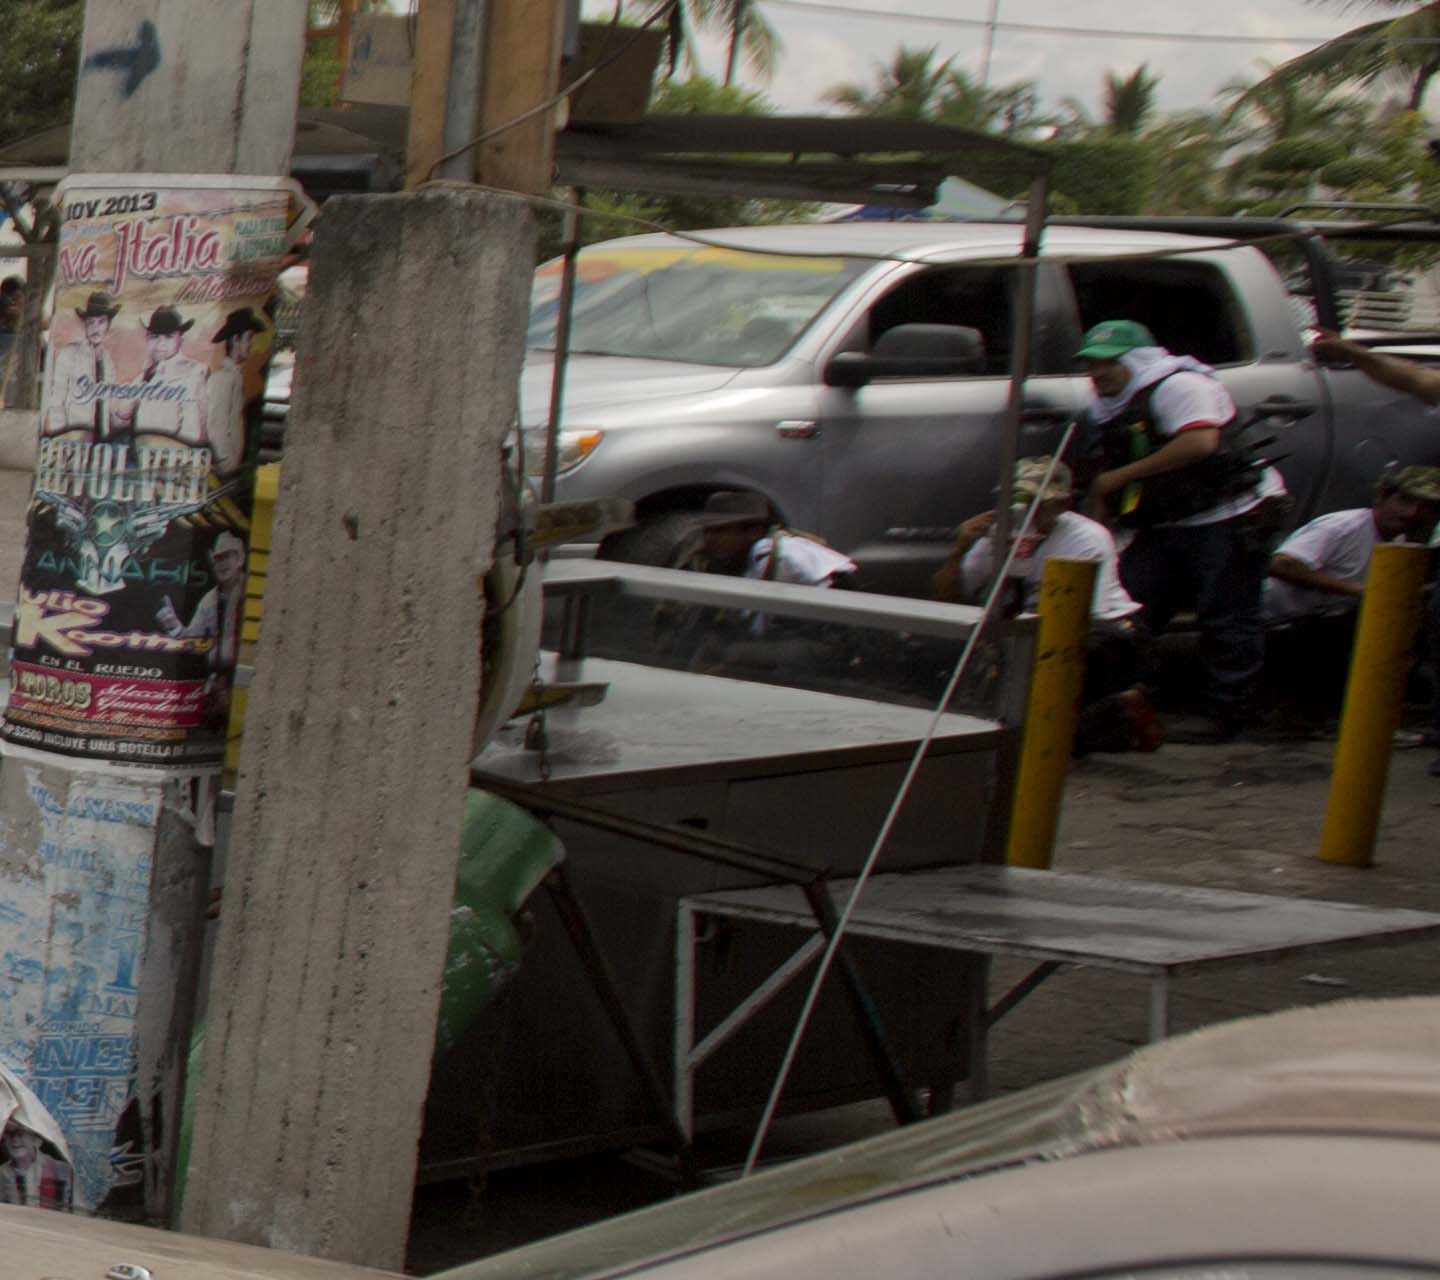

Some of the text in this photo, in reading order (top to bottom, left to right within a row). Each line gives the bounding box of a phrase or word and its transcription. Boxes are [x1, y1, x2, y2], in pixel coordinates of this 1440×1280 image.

[112, 217, 221, 297] Italia
[38, 437, 213, 504] REVOLVER
[40, 655, 163, 679] EN EL RUEDO
[88, 739, 116, 754] UNA
[117, 741, 172, 757] BOTELLA
